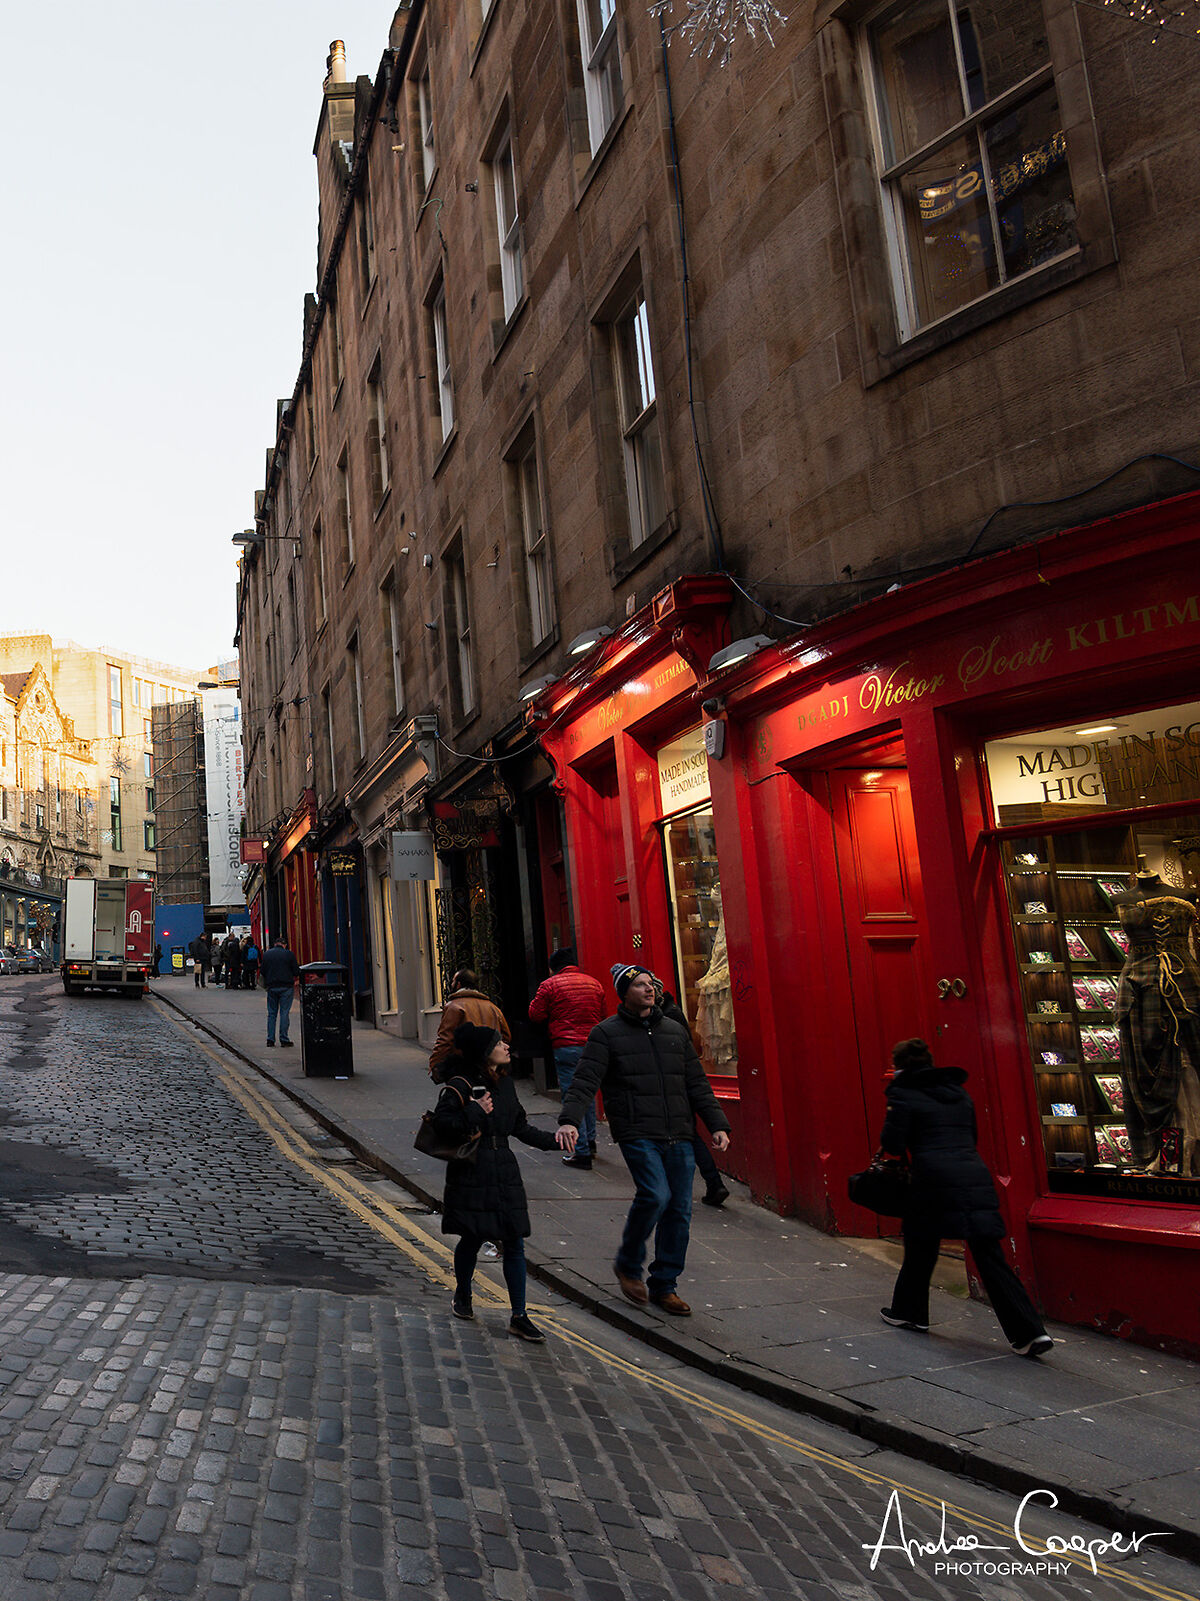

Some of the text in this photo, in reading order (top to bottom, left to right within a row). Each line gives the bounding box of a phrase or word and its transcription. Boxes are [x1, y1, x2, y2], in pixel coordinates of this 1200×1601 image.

[858, 660, 944, 714] Victor
[957, 635, 1055, 693] Scott
[1016, 739, 1112, 777] MADE
[1118, 730, 1160, 760] IN
[660, 762, 681, 784] MADE
[682, 758, 691, 775] IN
[670, 771, 707, 798] HANDMADE
[936, 978, 968, 999] 90
